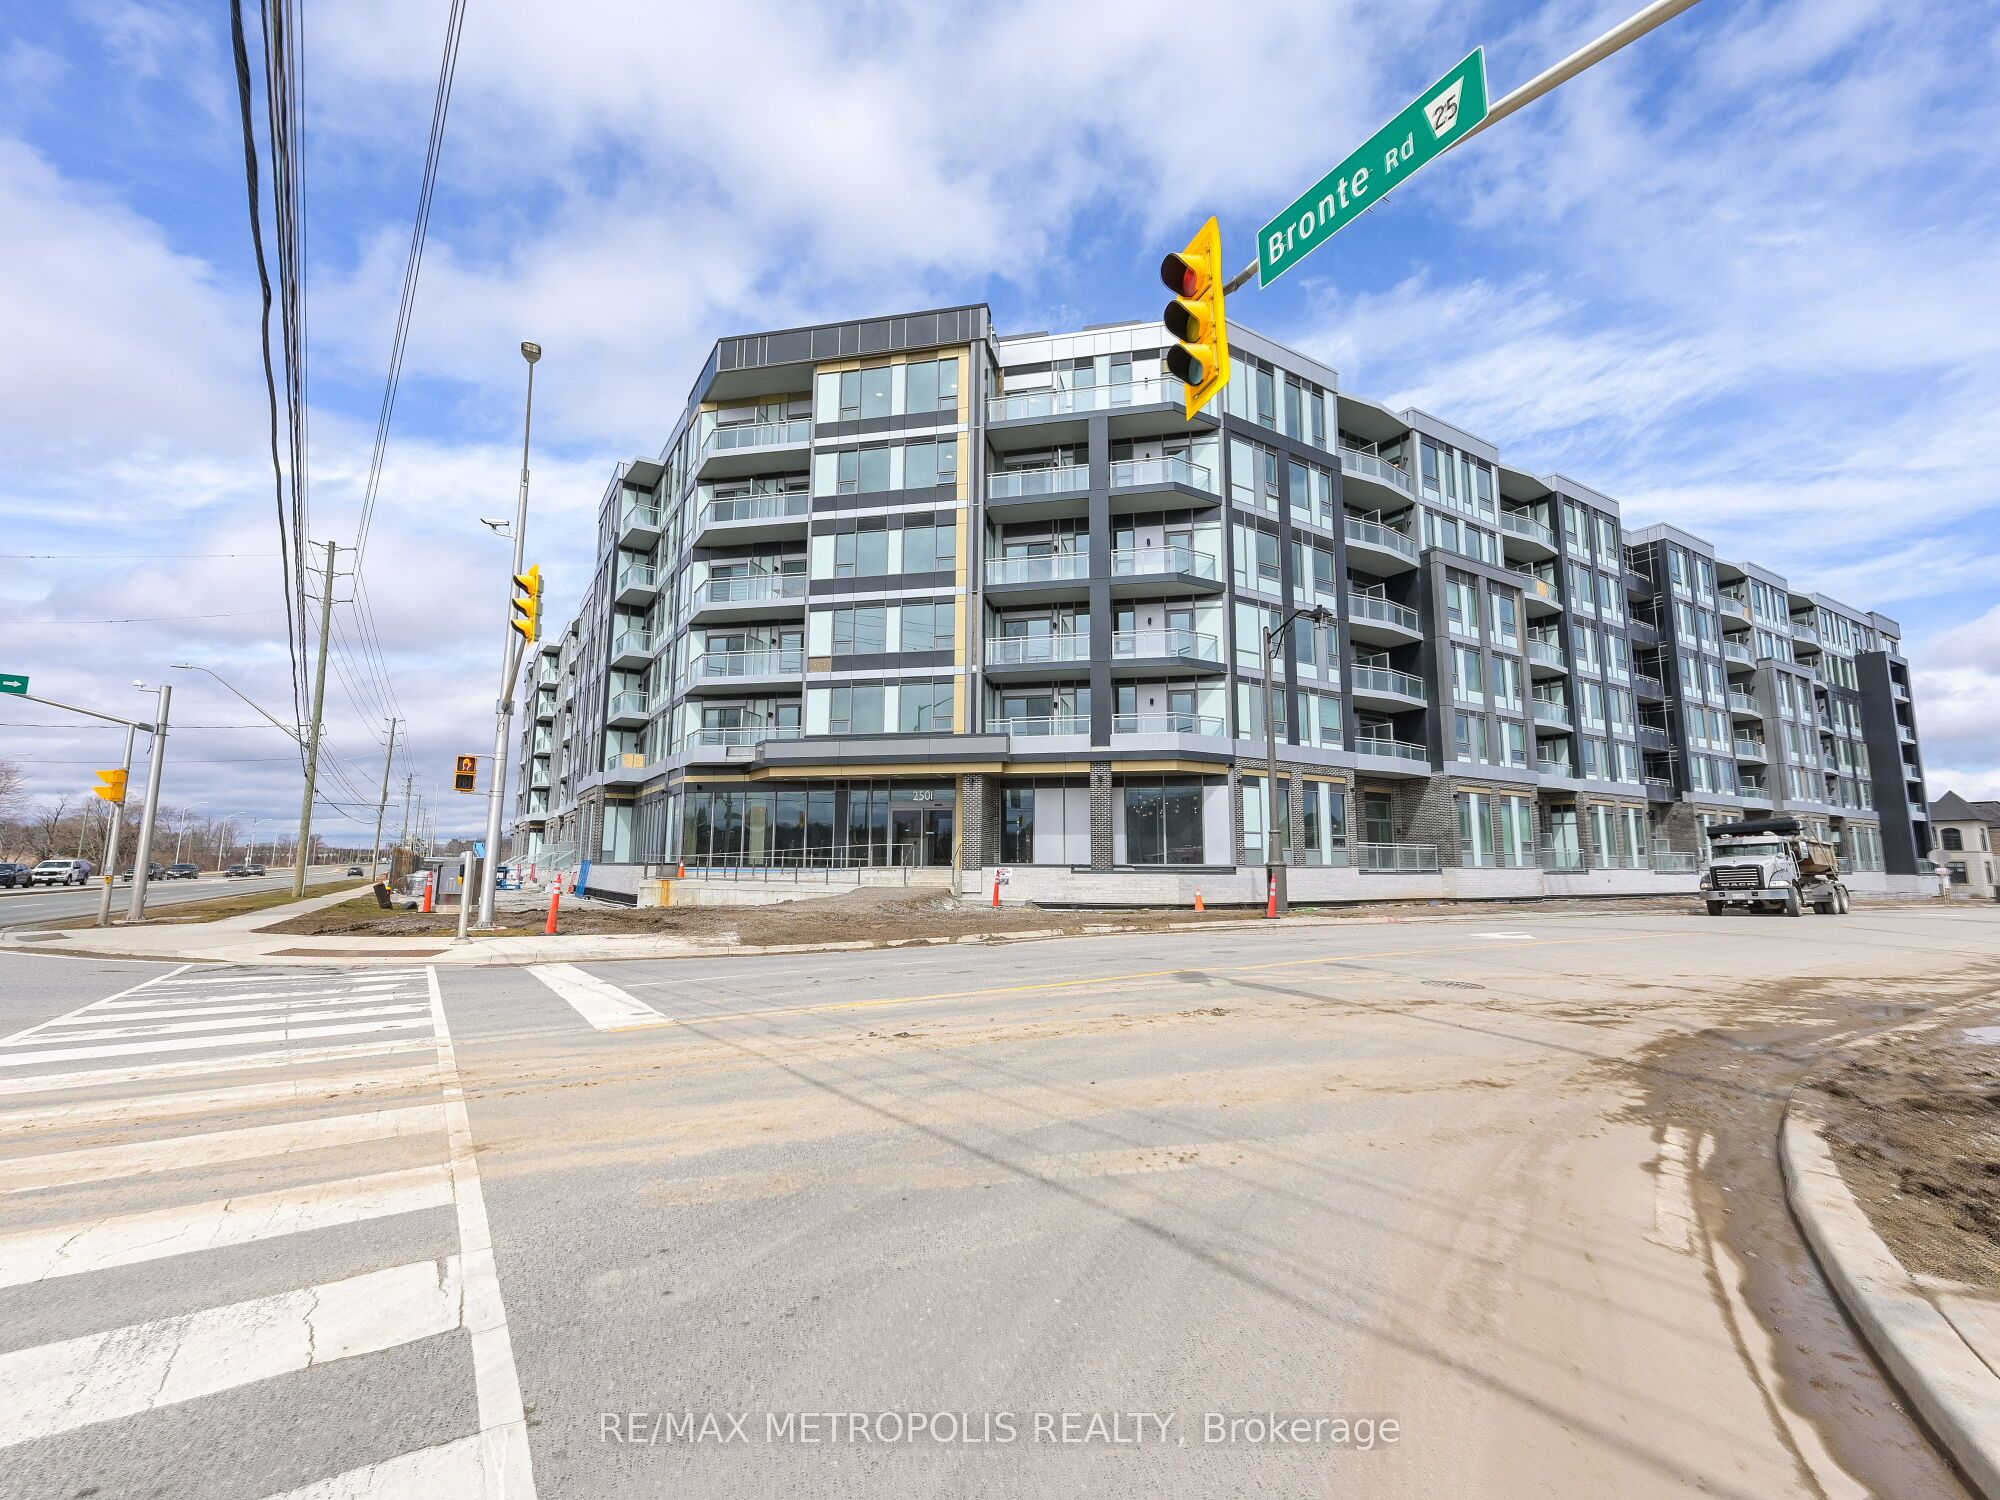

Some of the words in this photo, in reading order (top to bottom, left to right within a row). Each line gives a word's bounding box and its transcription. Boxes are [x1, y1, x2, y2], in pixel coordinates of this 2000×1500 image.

[1433, 94, 1459, 131] 25
[1268, 166, 1369, 266] Bronte
[1384, 131, 1415, 175] Rd
[912, 790, 933, 801] 2501
